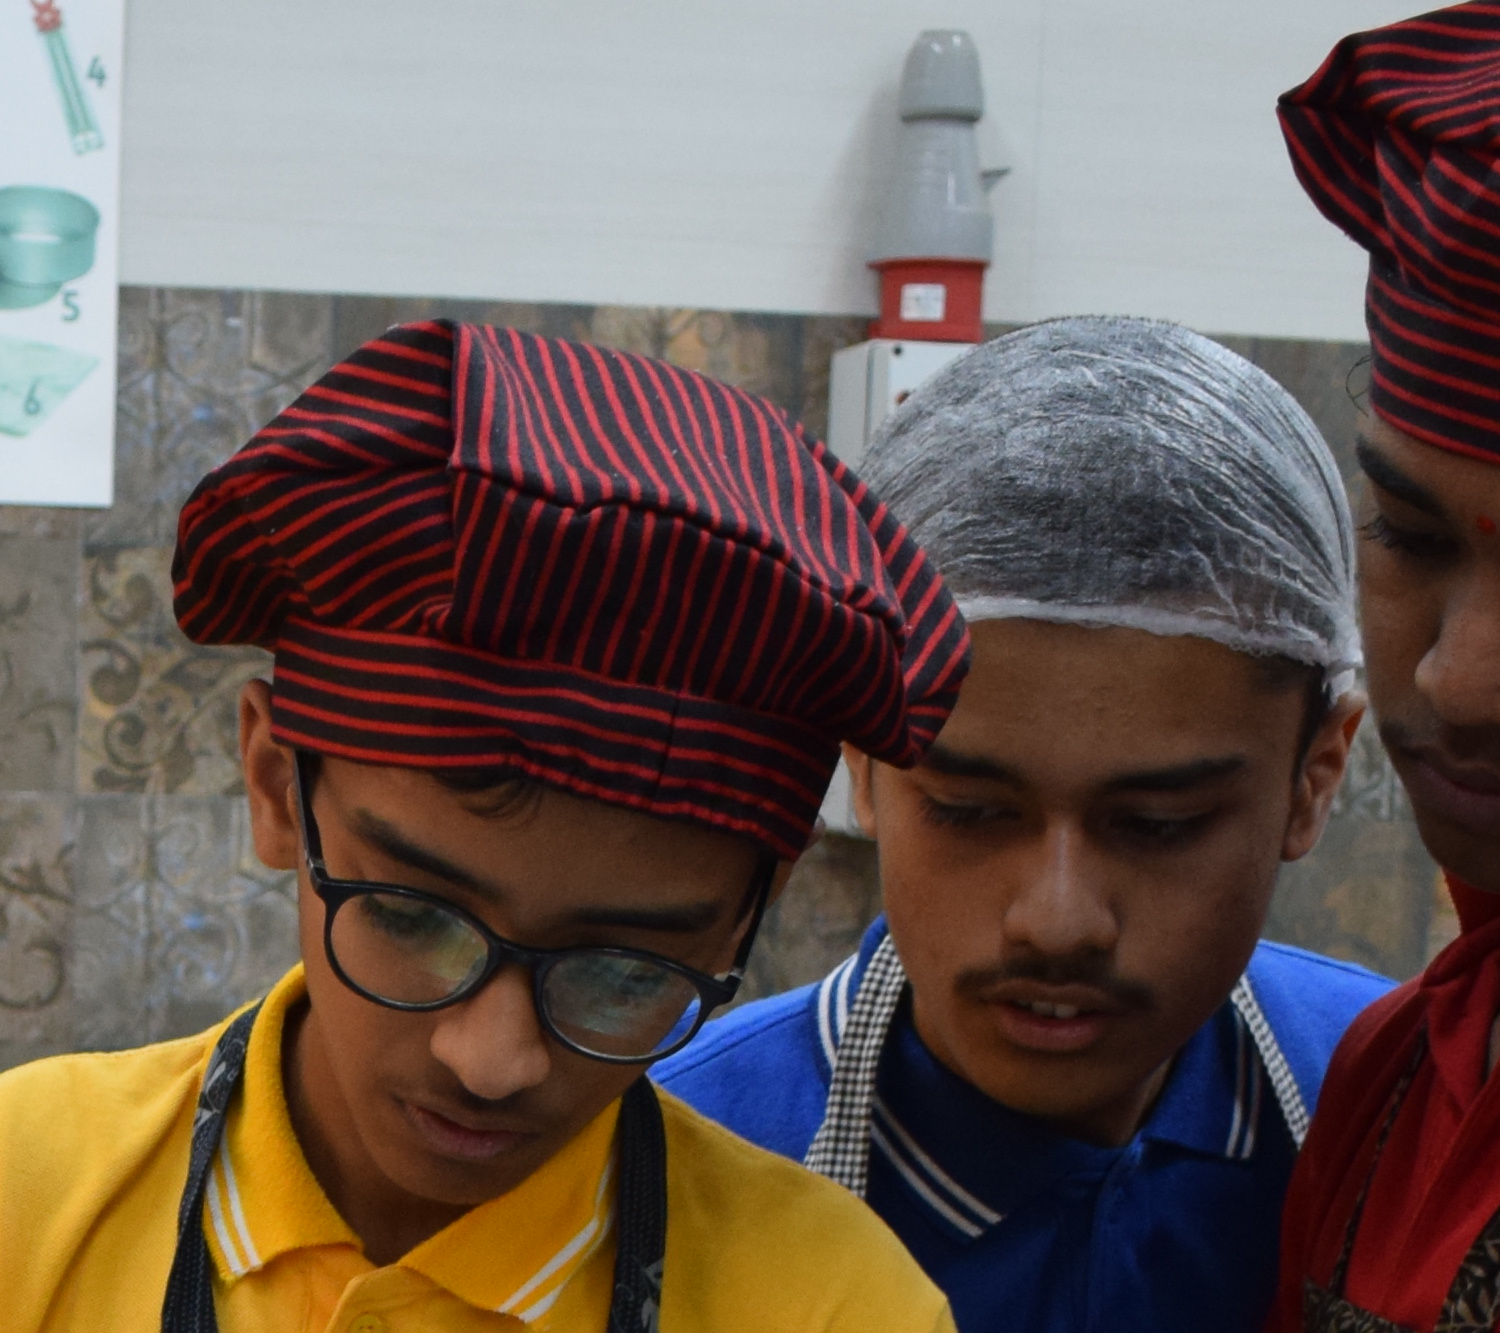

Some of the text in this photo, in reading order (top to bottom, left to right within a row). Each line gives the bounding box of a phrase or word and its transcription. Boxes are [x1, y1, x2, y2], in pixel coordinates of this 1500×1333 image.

[86, 55, 107, 88] 4
[61, 291, 80, 323] 5
[24, 384, 43, 417] 6
